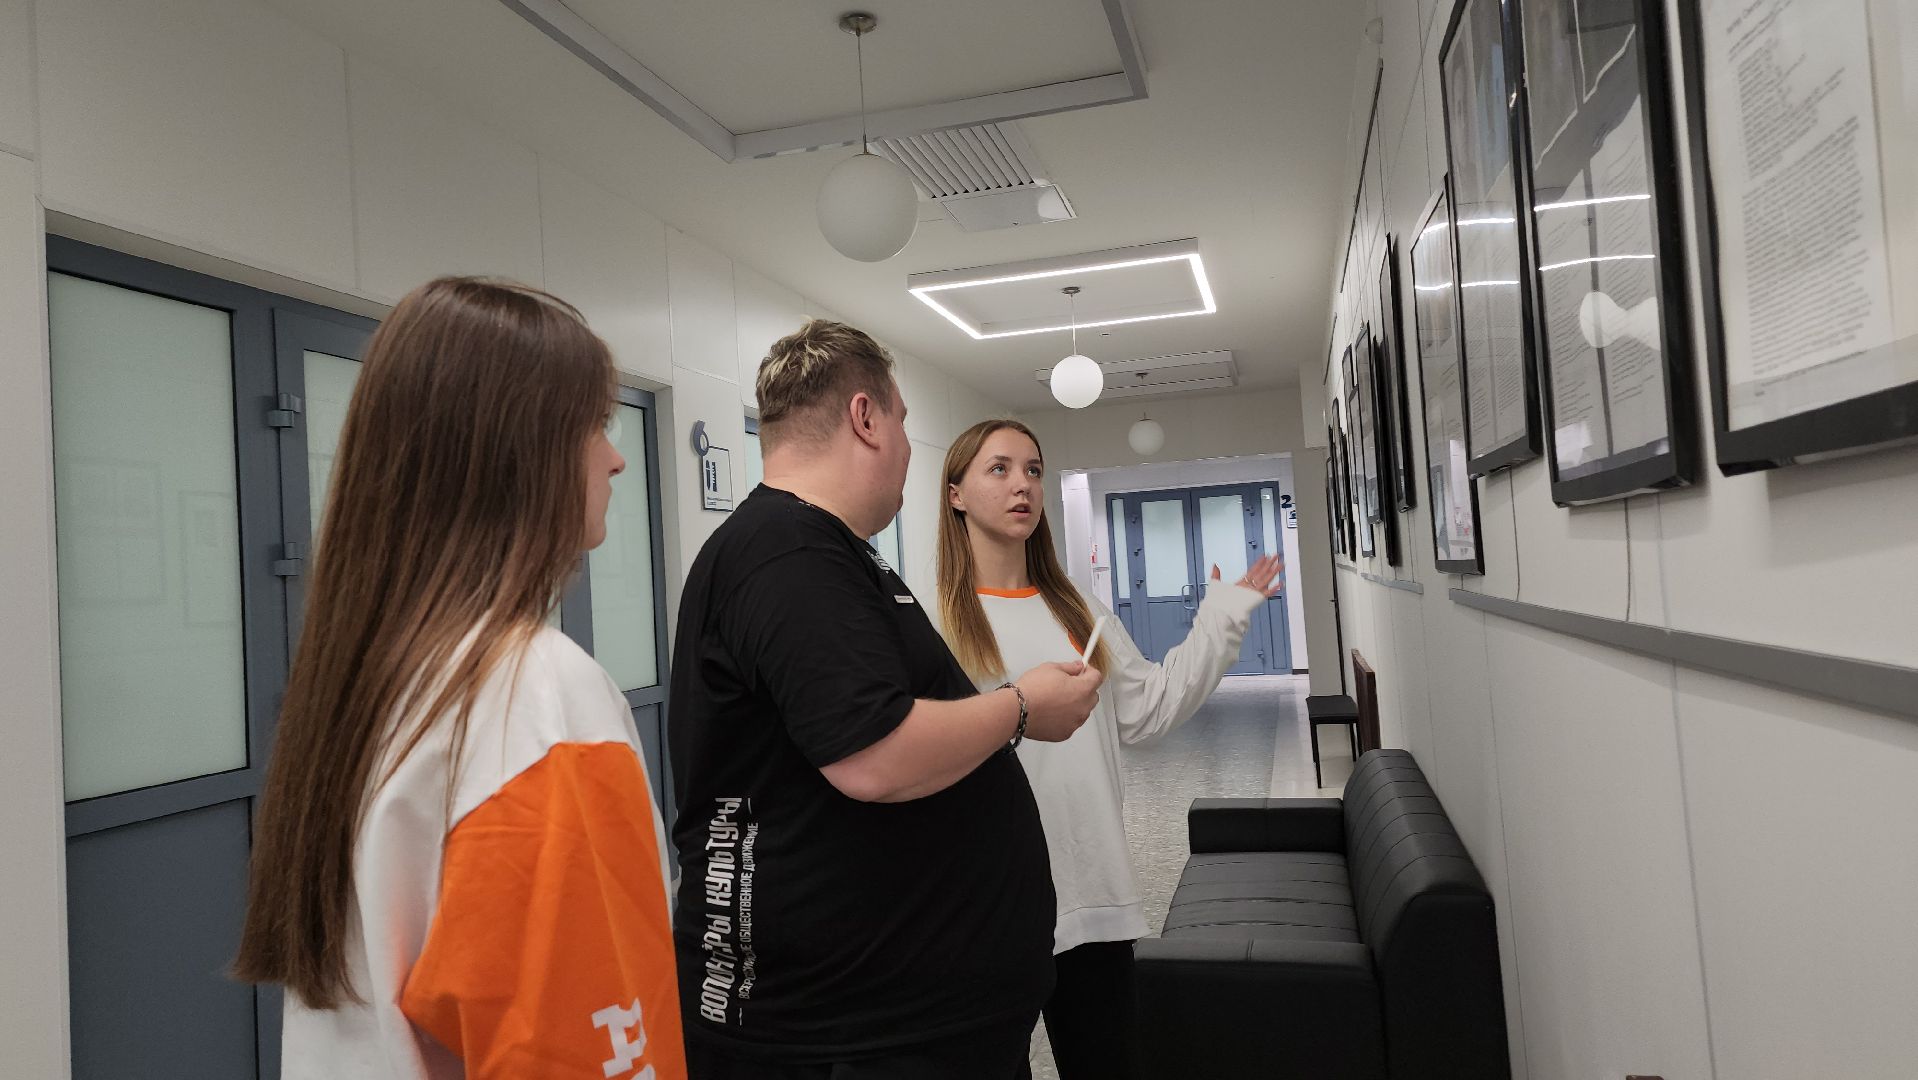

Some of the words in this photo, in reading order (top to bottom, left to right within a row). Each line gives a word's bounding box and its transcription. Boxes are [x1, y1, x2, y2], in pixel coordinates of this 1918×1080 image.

[1280, 494, 1292, 509] 2
[705, 797, 743, 907] КУЛЬТУРЫ
[742, 822, 759, 872] ДВИЖЕНИЕ
[739, 872, 753, 943] ОБЩЕСТВЕННОЕ
